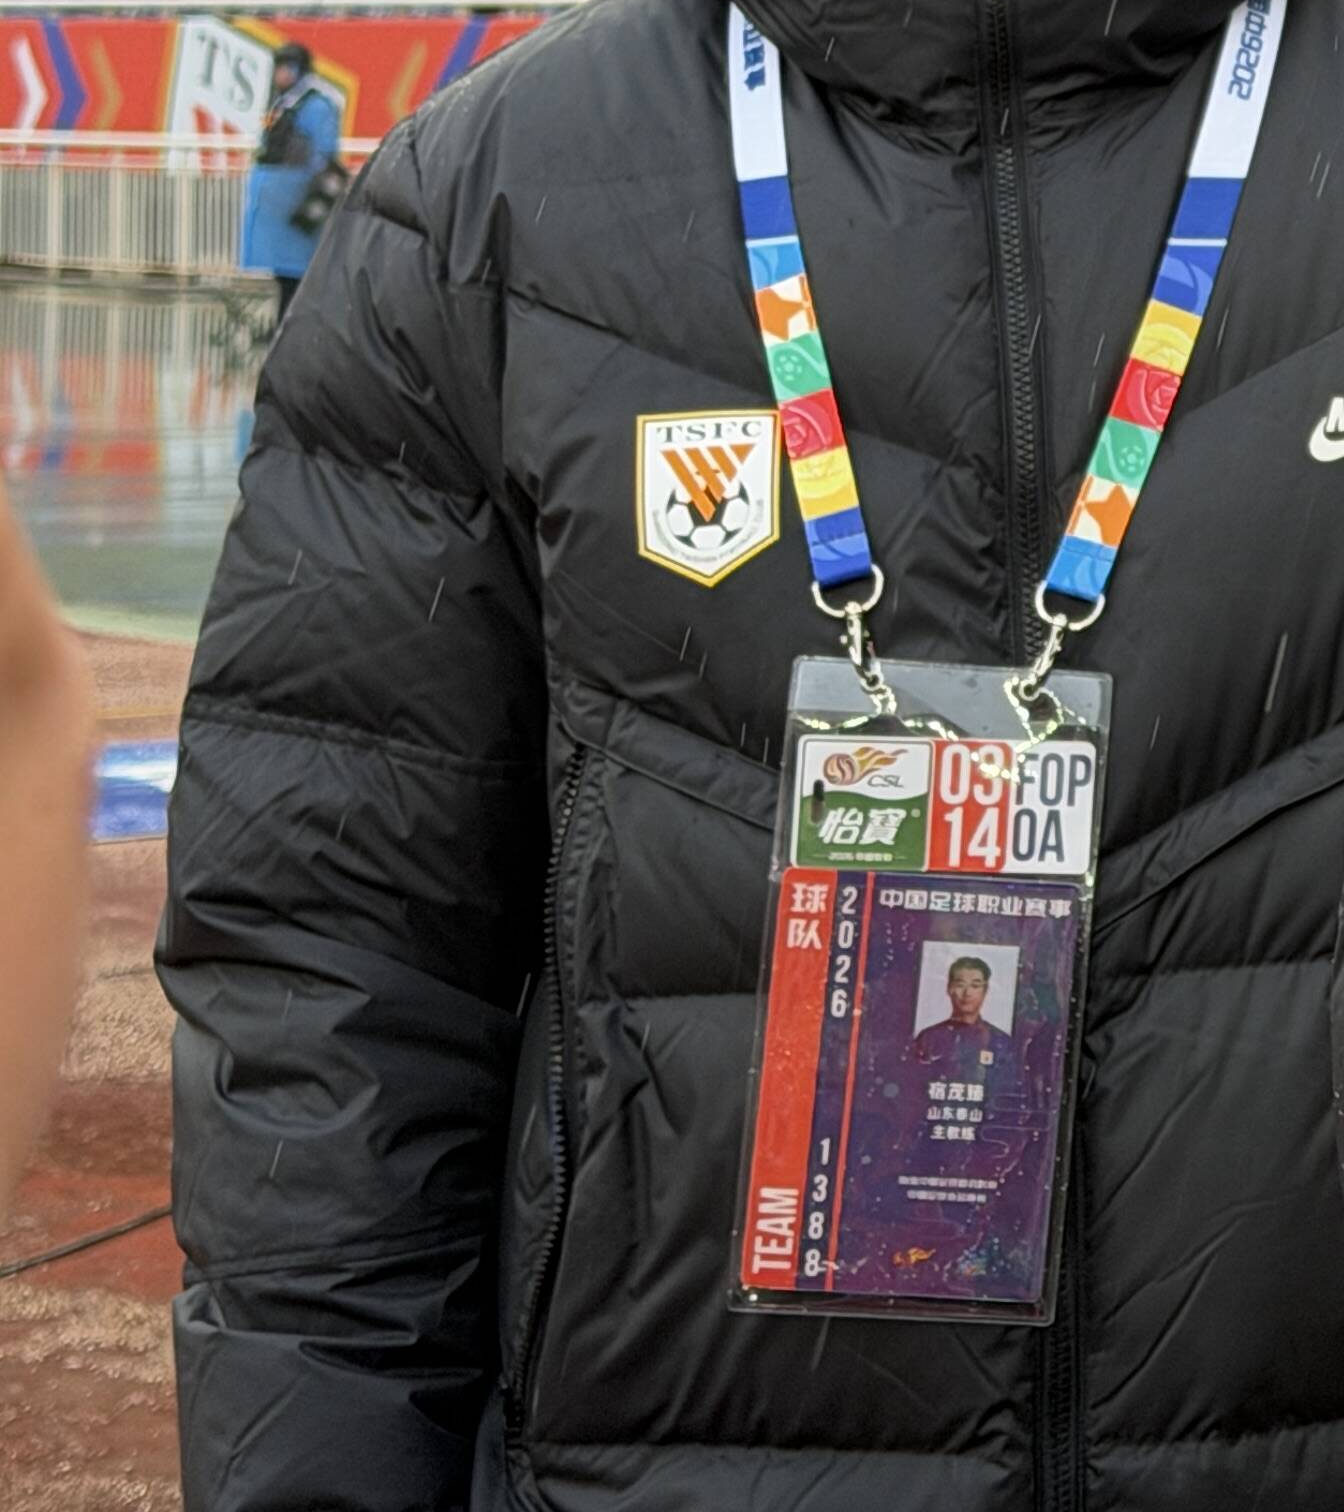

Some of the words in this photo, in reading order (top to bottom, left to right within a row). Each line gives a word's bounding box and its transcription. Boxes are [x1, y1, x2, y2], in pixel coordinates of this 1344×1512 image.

[656, 420, 762, 443] TSFC
[939, 743, 1005, 807] 03
[1014, 752, 1093, 808] FOP
[944, 806, 1003, 868] 14
[1012, 808, 1066, 863] OA
[786, 882, 830, 950] 球队
[879, 889, 1073, 919] 中国足球职业赛事
[830, 886, 859, 1017] 2026
[752, 1186, 800, 1275] TEAM
[804, 1137, 832, 1278] 1388
